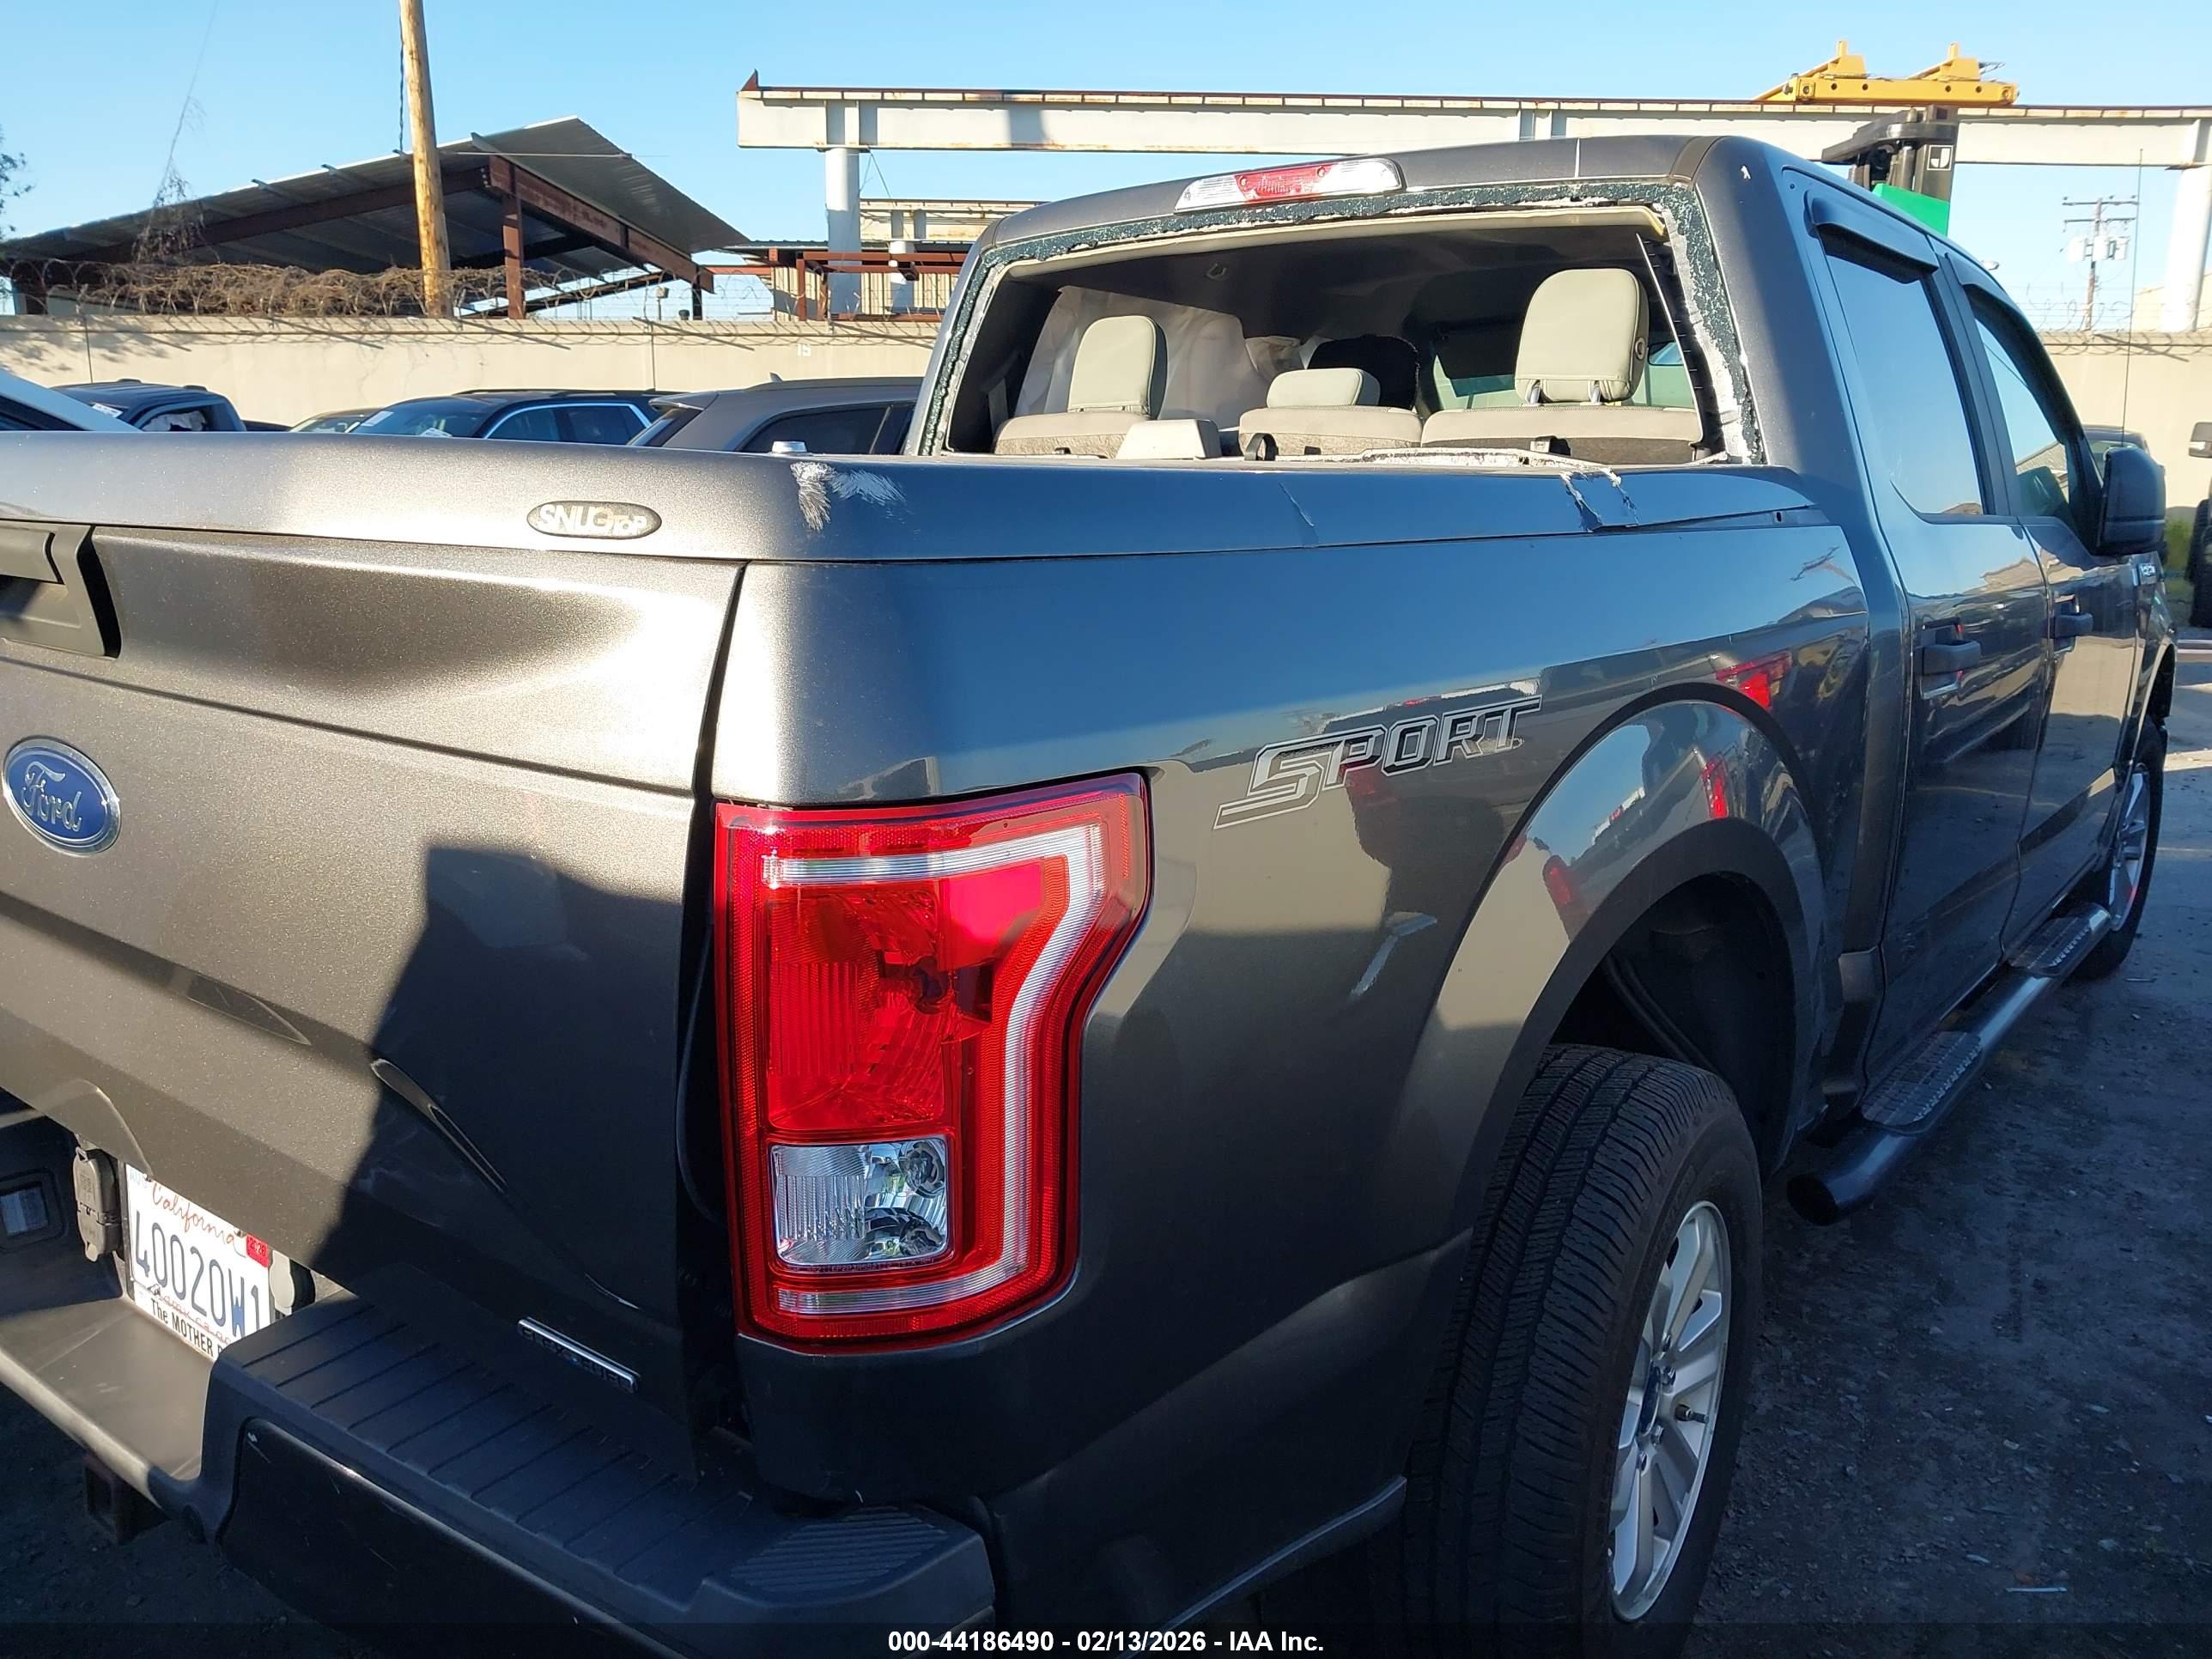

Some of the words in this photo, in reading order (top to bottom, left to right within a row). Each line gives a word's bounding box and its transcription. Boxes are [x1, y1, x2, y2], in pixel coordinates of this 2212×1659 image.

[21, 761, 82, 832] Ford
[1212, 694, 1543, 830] SPORT
[151, 1182, 246, 1258] California
[136, 1209, 260, 1338] 40020W1
[151, 1297, 169, 1324] The
[172, 1312, 213, 1357] MOTHER
